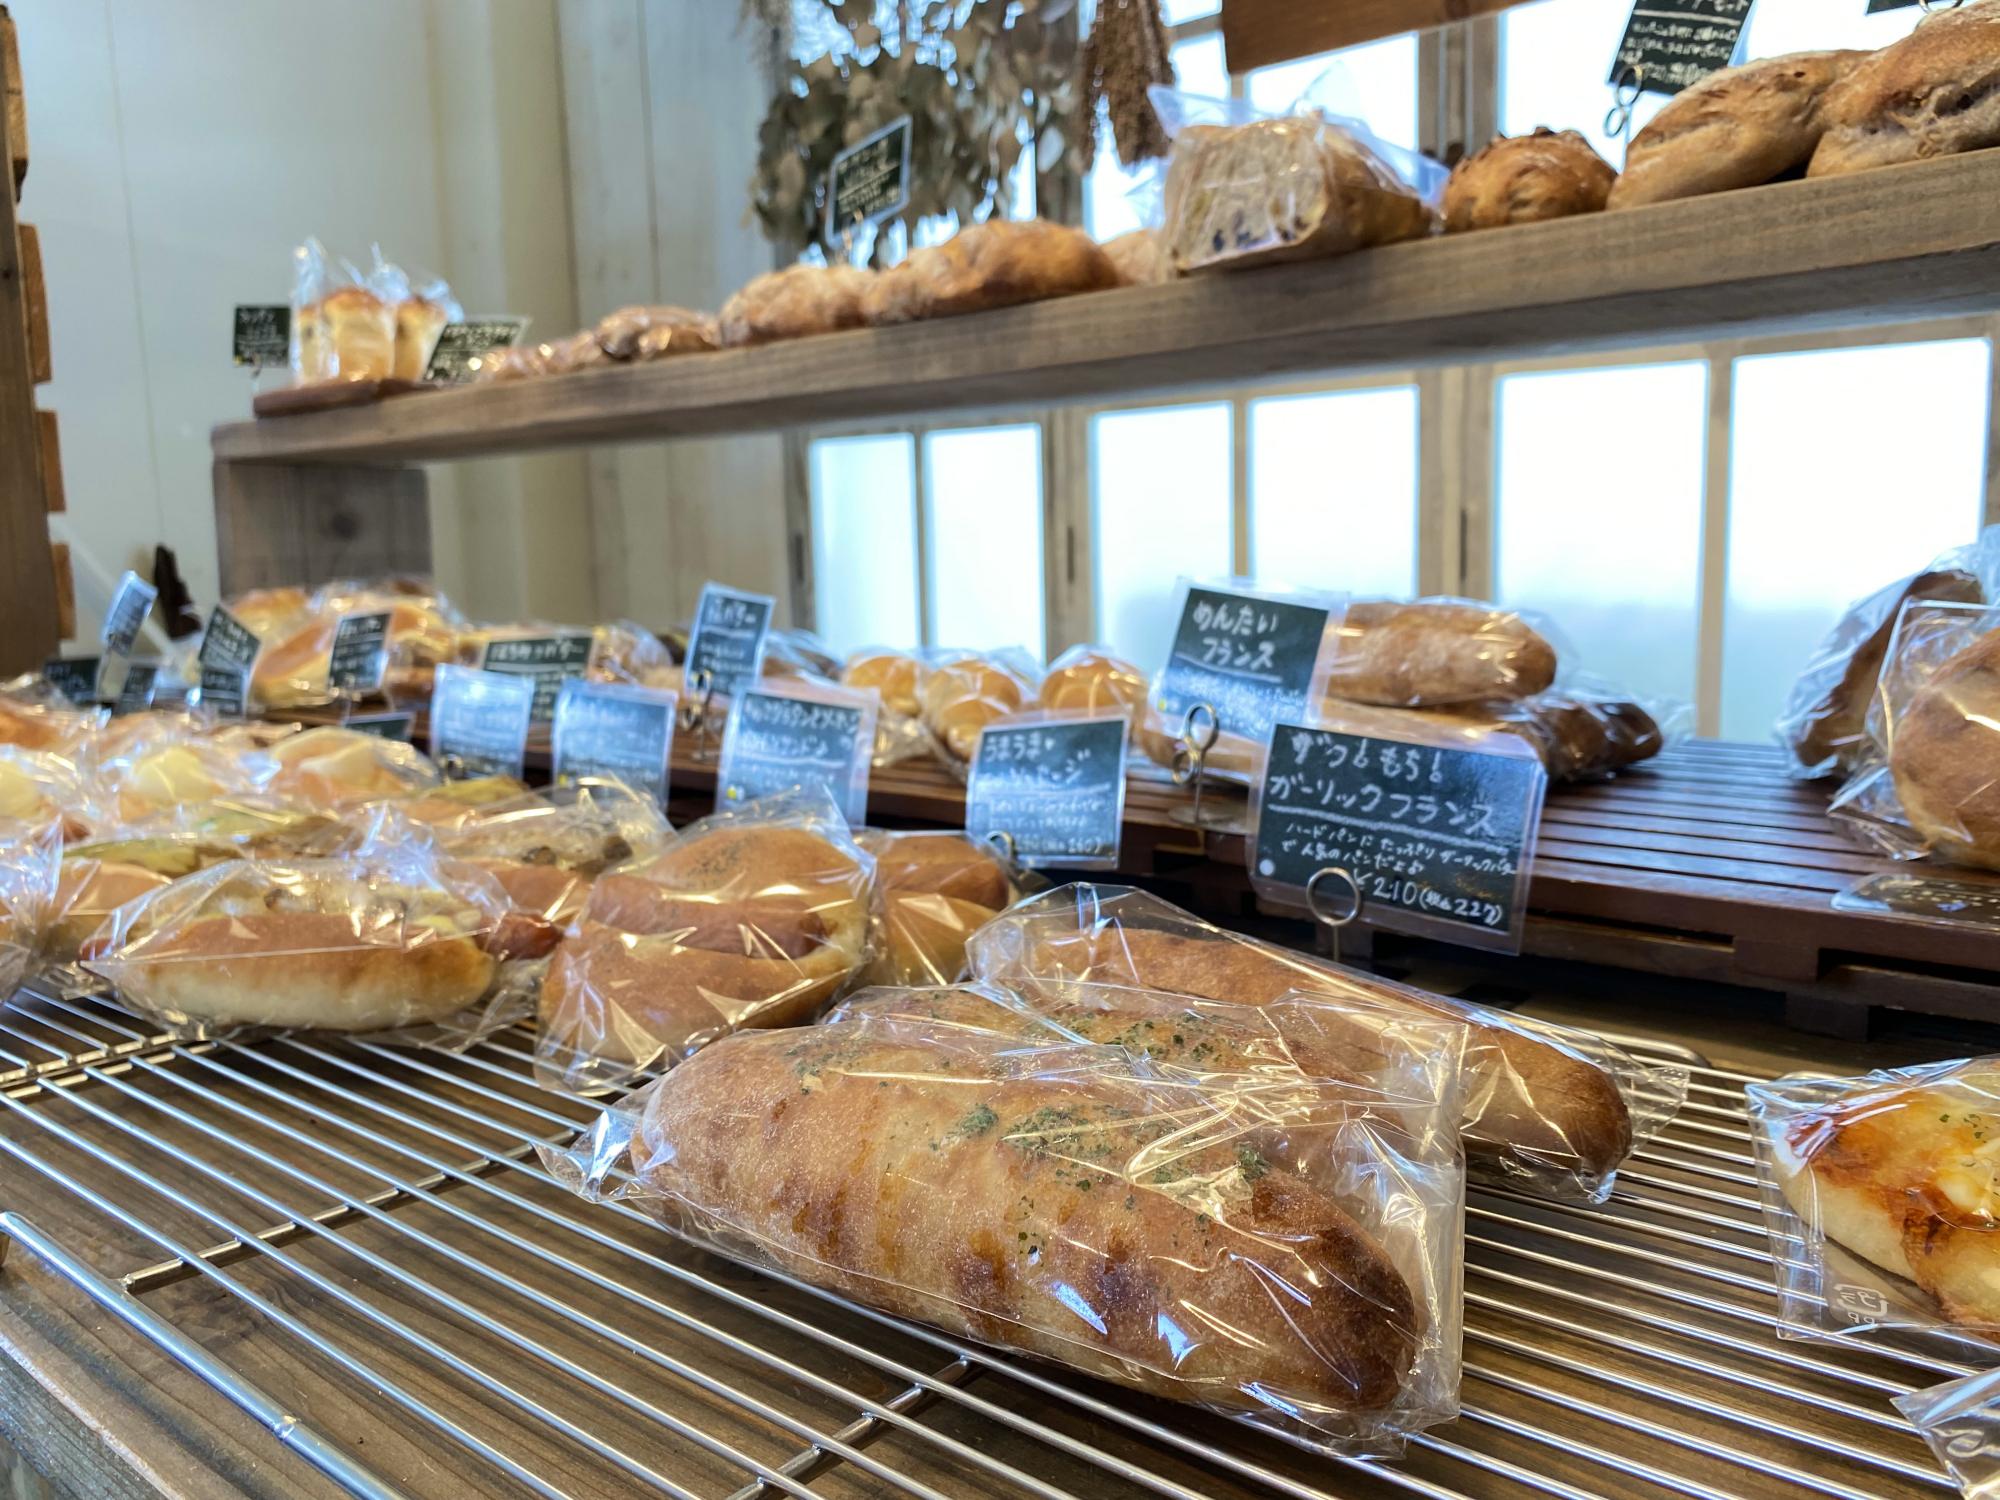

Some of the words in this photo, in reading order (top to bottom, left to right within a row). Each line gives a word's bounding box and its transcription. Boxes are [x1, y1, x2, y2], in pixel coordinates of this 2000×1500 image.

[1193, 600, 1279, 635] めんたい
[1202, 636, 1275, 669] フランス
[1270, 773, 1497, 838] ガーリックフランス
